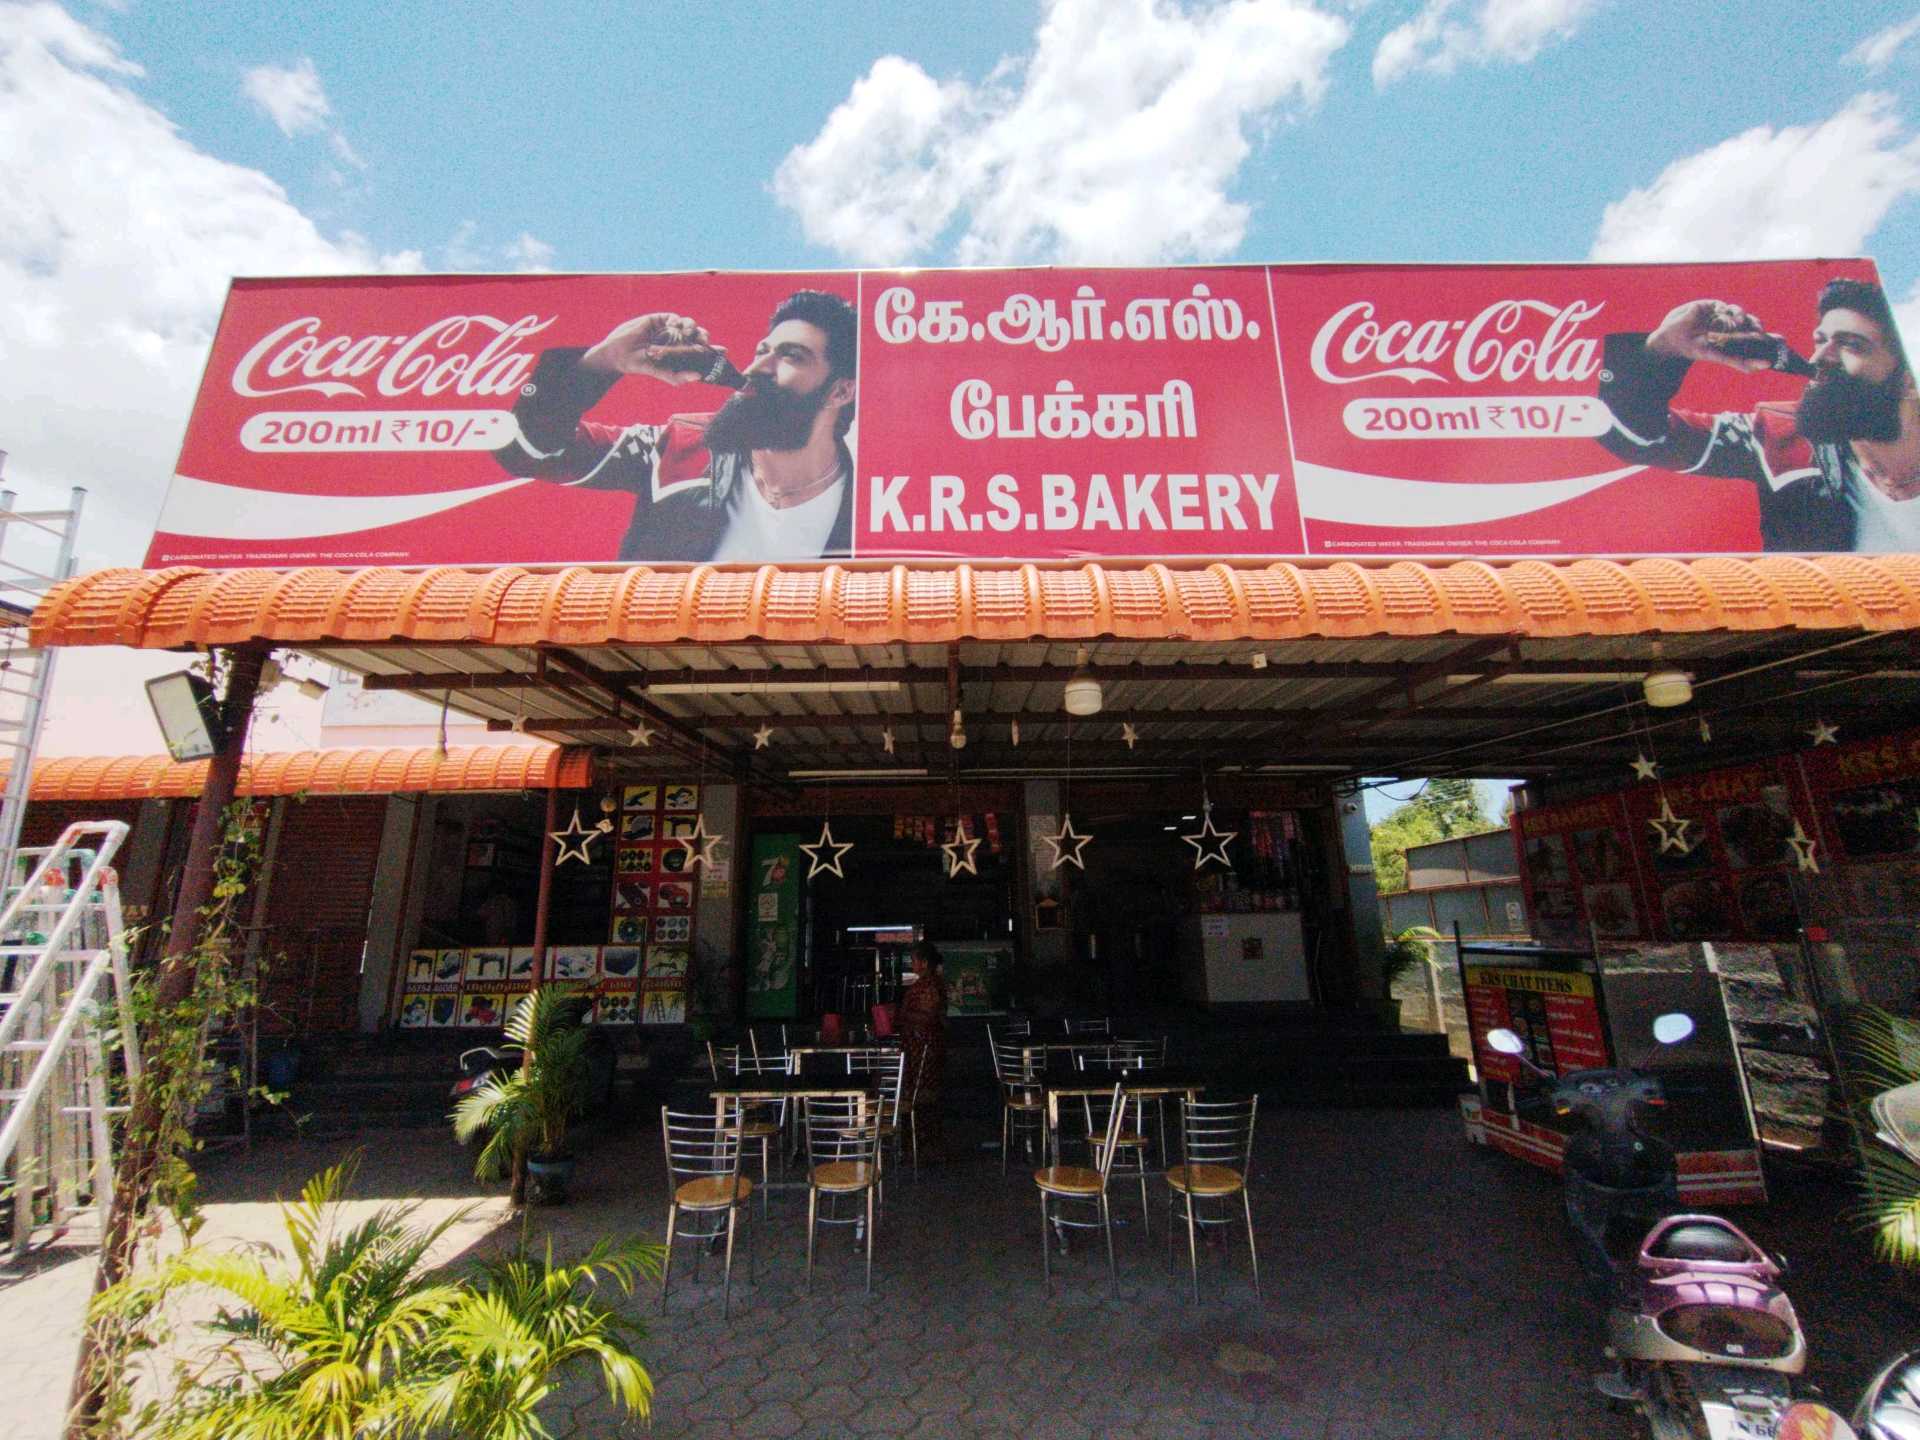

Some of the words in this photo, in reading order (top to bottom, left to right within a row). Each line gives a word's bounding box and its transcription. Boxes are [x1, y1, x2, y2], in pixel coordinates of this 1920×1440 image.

[950, 379, 1197, 440] பேக்கரி
[1363, 406, 1480, 431] 200ml
[260, 420, 381, 444] 200ml
